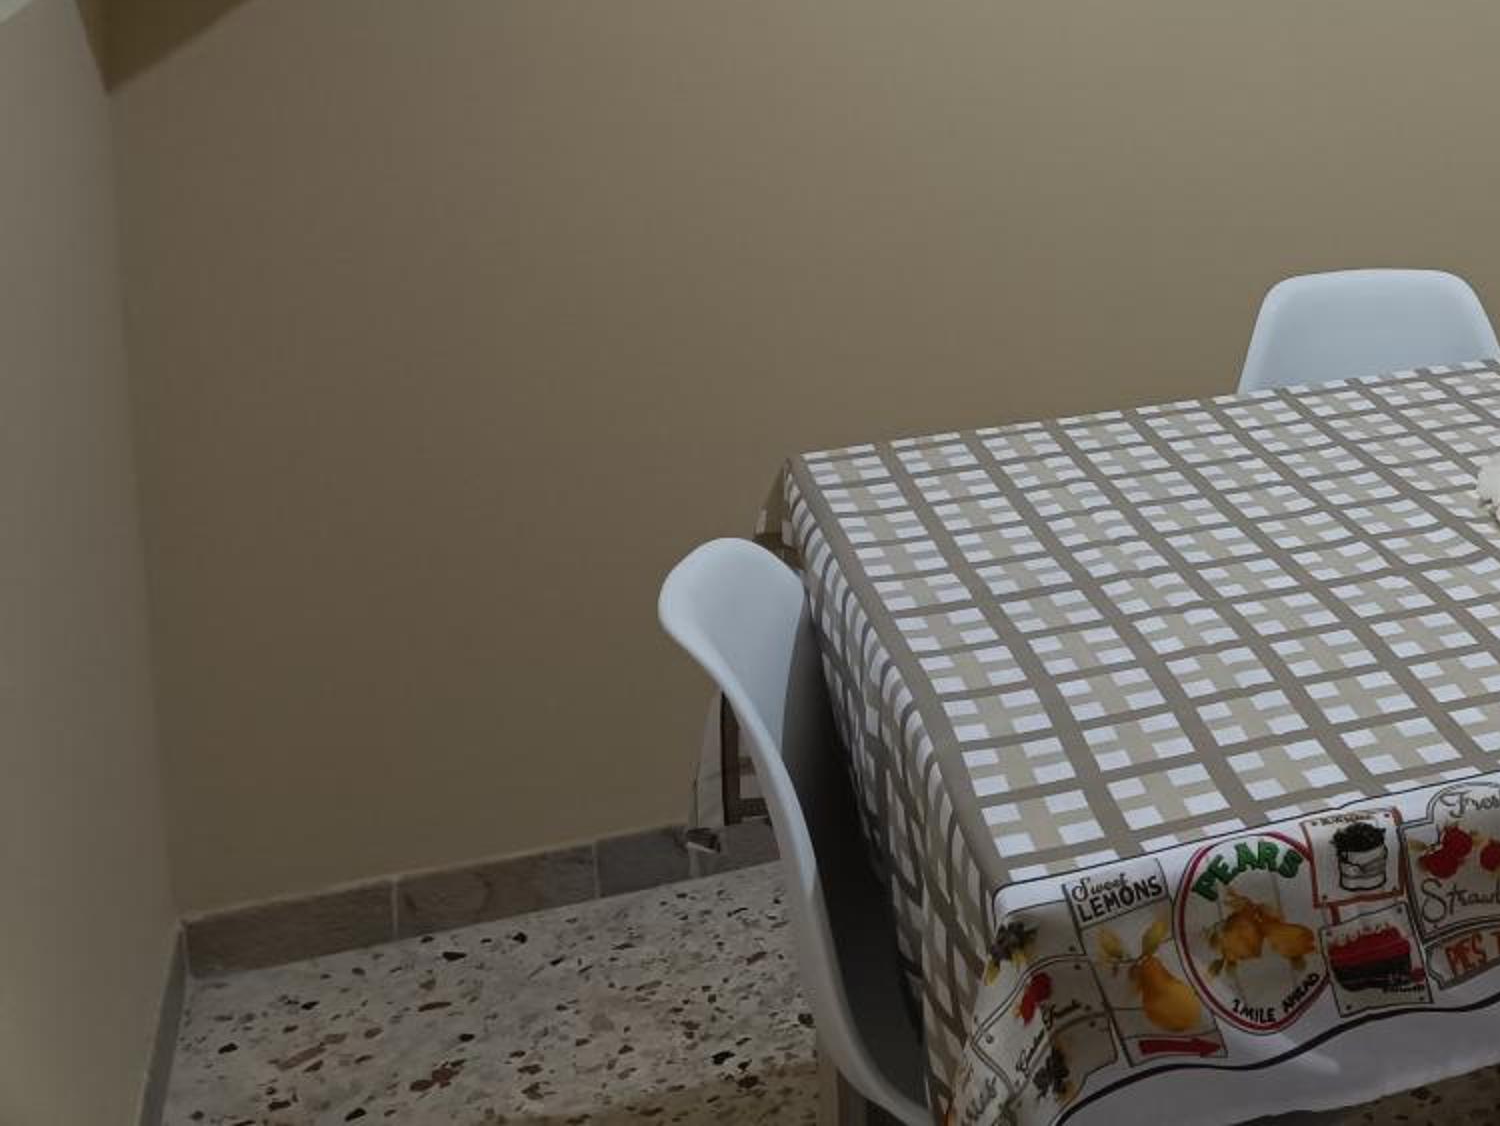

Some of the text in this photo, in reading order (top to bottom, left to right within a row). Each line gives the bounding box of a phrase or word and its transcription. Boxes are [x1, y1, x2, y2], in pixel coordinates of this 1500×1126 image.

[1192, 841, 1303, 902] PEARS
[1079, 875, 1163, 924] LEMONS
[1240, 1004, 1277, 1024] MILE
